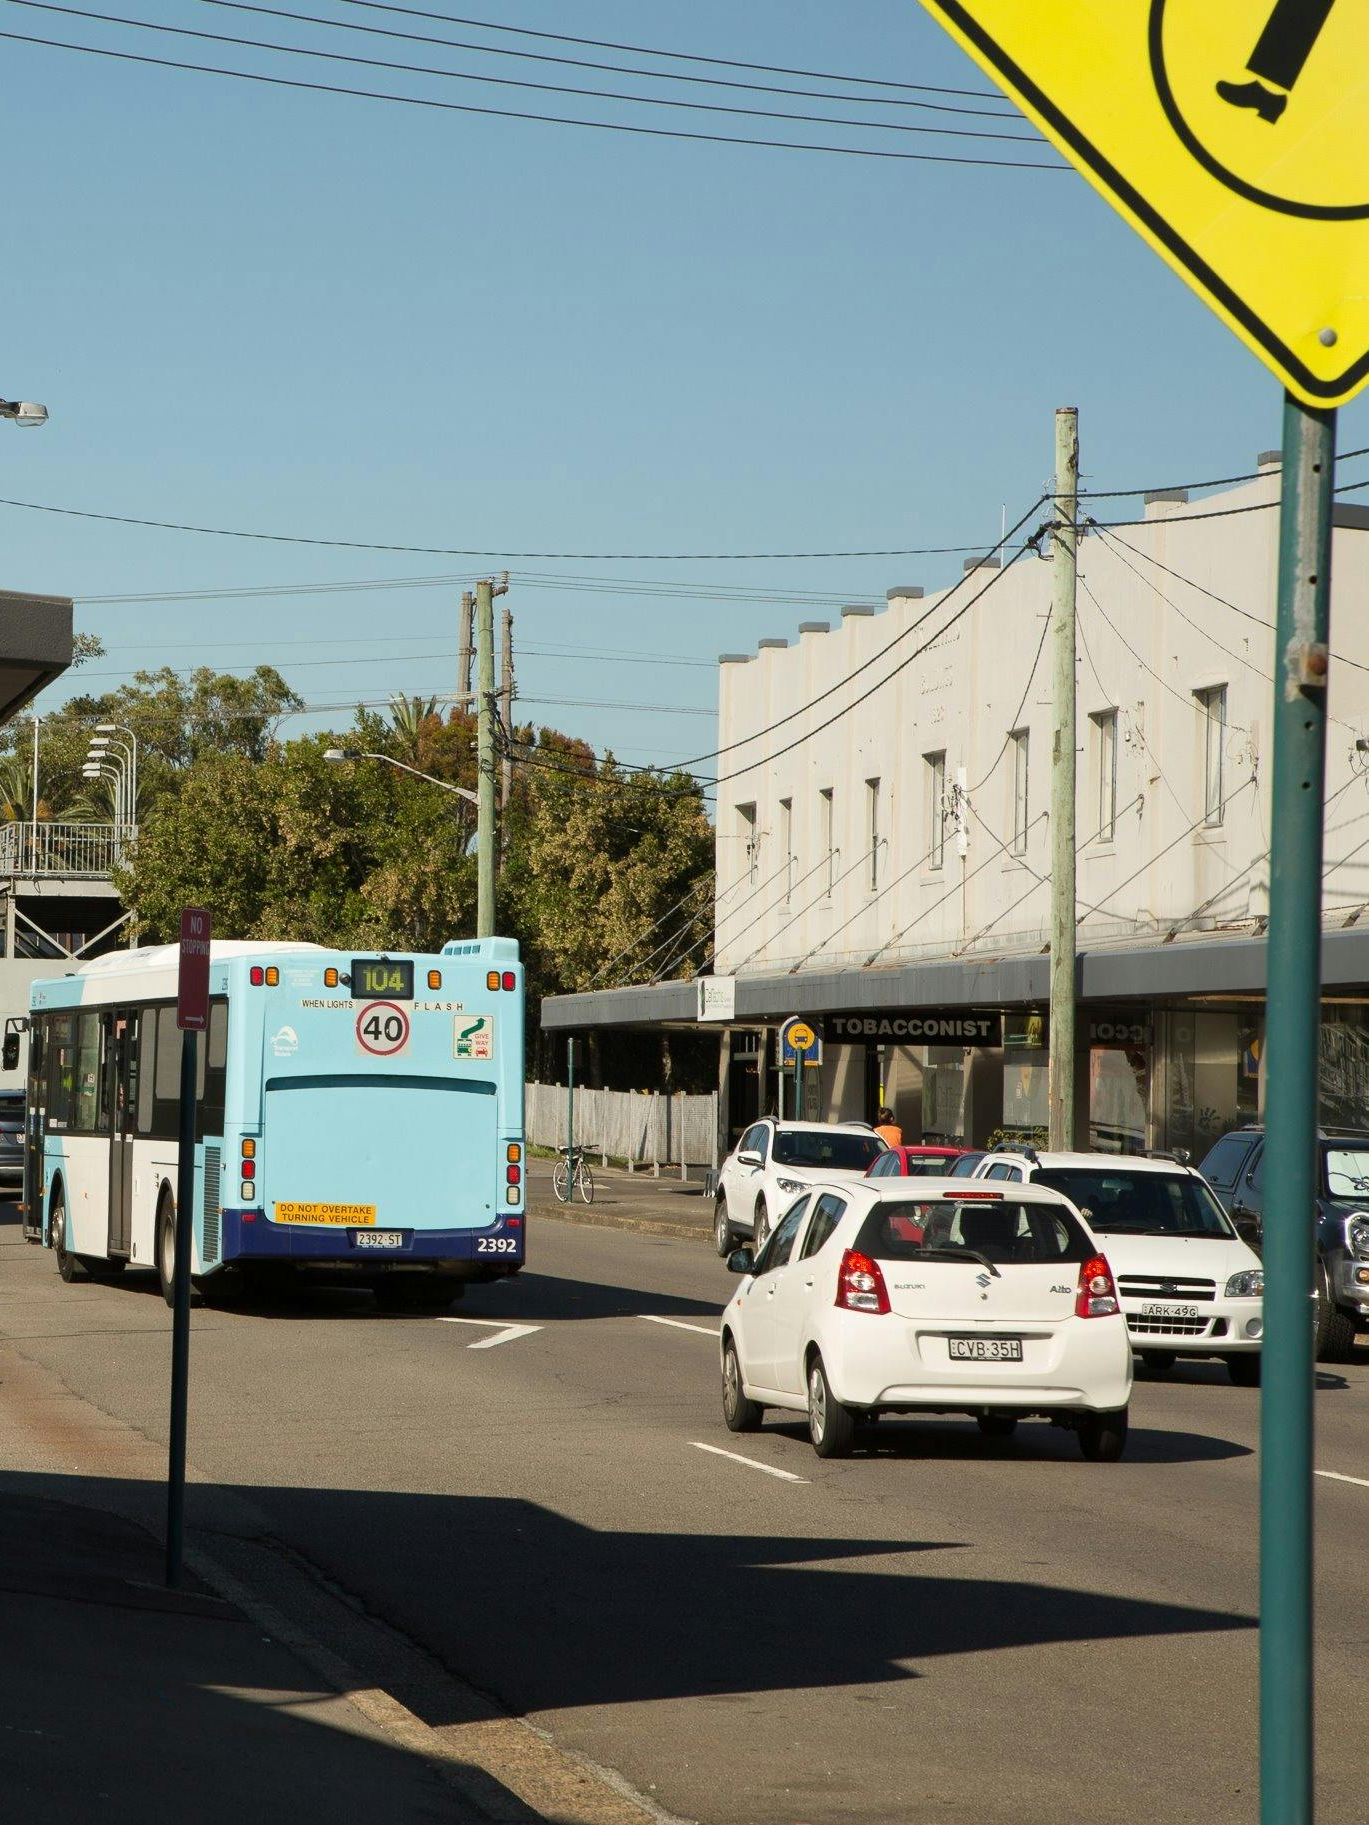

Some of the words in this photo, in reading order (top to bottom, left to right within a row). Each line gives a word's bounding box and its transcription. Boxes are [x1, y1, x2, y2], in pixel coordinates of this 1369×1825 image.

[190, 915, 203, 935] NO
[181, 939, 210, 955] STOPPING
[362, 966, 405, 992] 104
[302, 1000, 325, 1008] WHEN
[327, 1000, 353, 1009] LIGHTS
[414, 1003, 463, 1011] FLASH
[363, 1015, 403, 1042] 40
[832, 1018, 991, 1037] TOBACCONIST
[280, 1203, 296, 1212] DO
[298, 1204, 318, 1213] NOT
[321, 1205, 372, 1214] OVERTAKE
[282, 1213, 325, 1222] TURNING
[328, 1214, 370, 1224] VEHICLE
[477, 1238, 517, 1253] 2392
[1049, 1285, 1072, 1294] Alto
